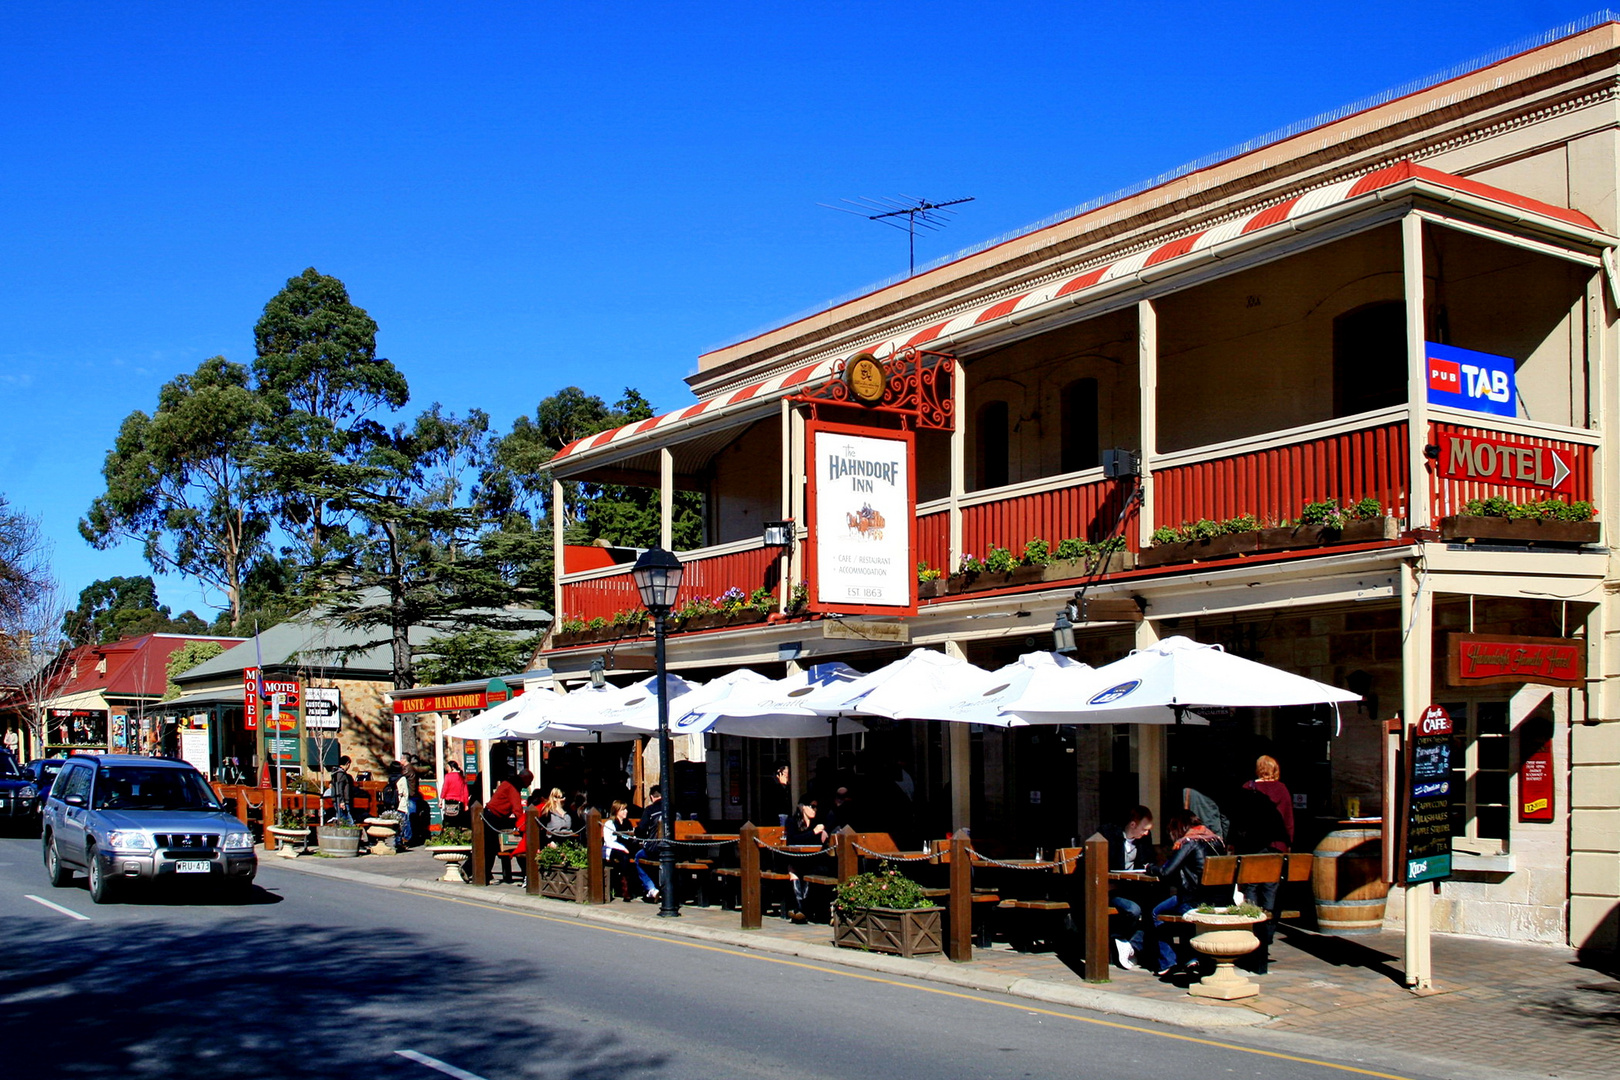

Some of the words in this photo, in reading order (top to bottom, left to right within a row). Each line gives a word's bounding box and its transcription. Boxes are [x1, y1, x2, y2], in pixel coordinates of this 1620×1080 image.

[1432, 369, 1457, 382] PUB
[1461, 364, 1509, 403] TAB
[843, 444, 856, 458] The
[1448, 437, 1553, 487] MOTEL
[829, 454, 898, 486] HAHNDORF
[852, 477, 873, 493] INN
[838, 554, 851, 563] CAFE
[858, 555, 890, 565] RESTAURANT
[839, 566, 887, 576] ACCOMMODATION
[864, 588, 882, 598] 1863
[265, 682, 298, 693] MOTEL
[246, 669, 256, 727] MOTEL
[402, 699, 425, 711] TASTE
[435, 694, 481, 709] HAHNDORF
[1423, 718, 1447, 733] CAFE
[1415, 812, 1449, 824] MILKSHAKES
